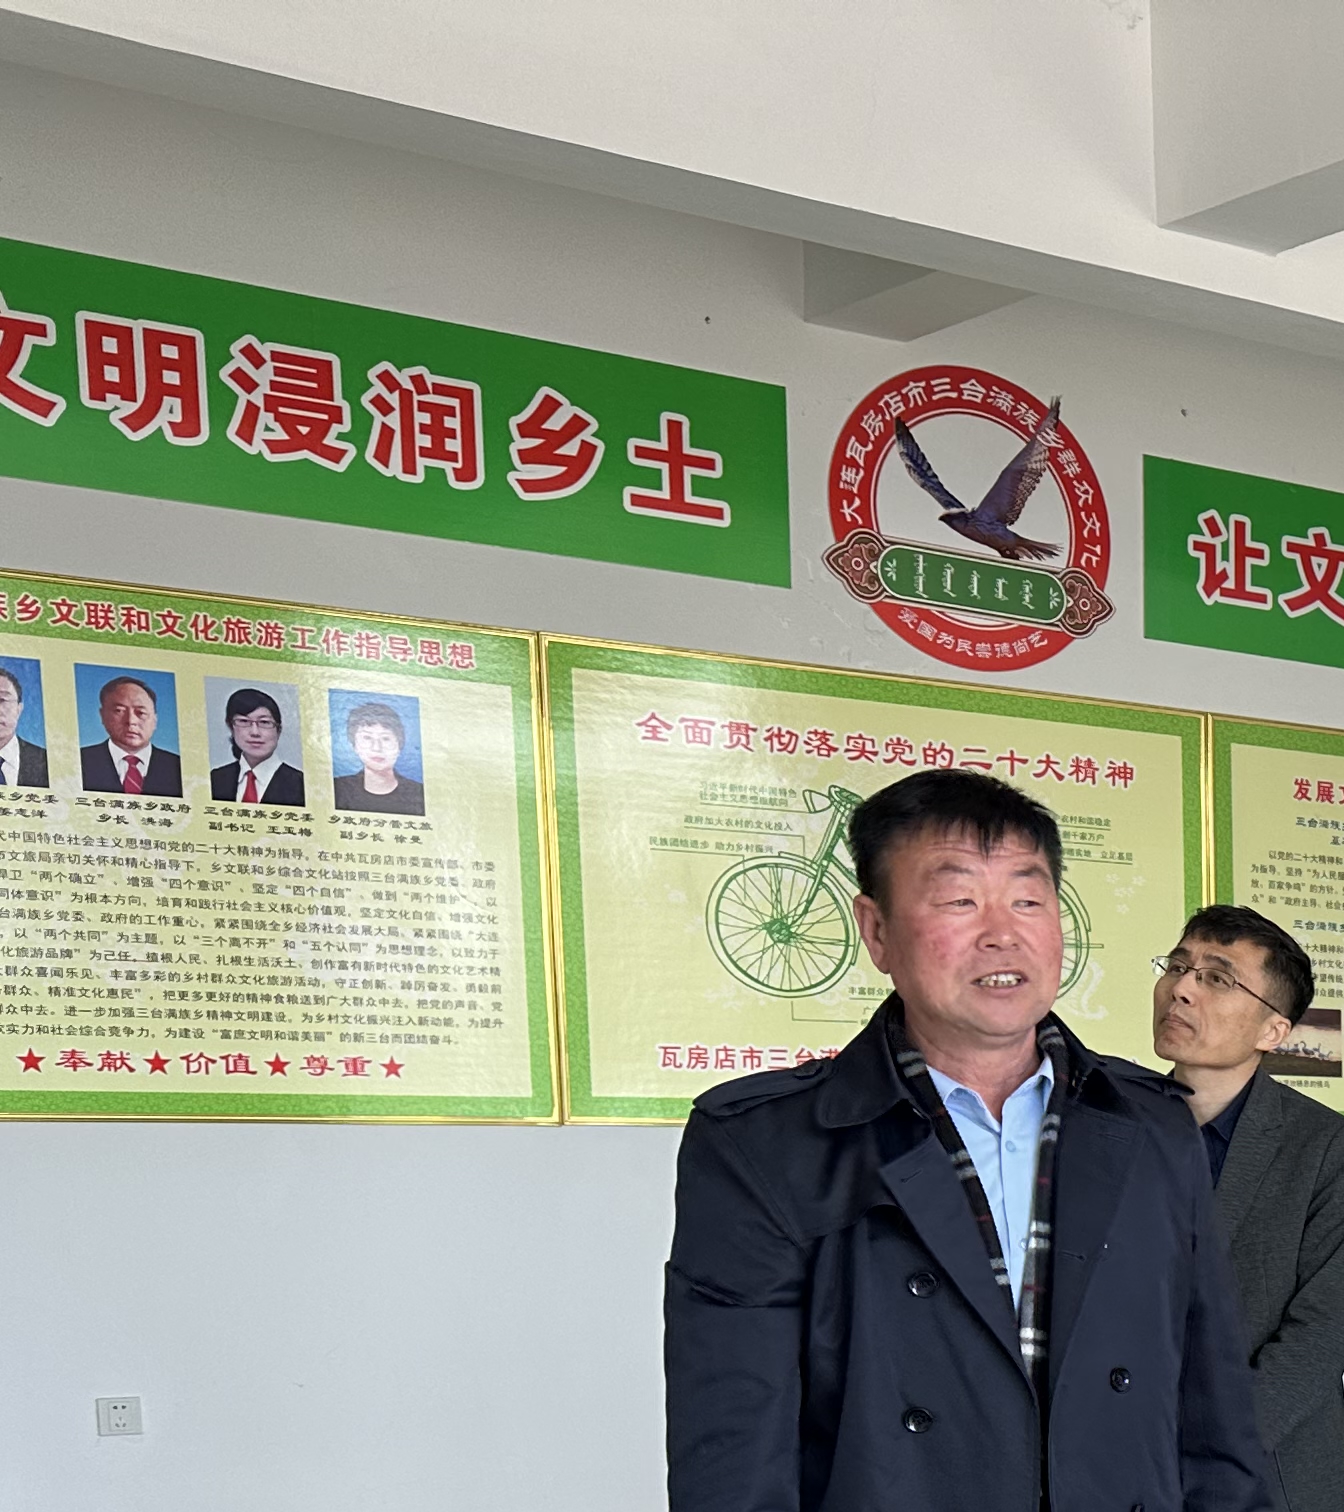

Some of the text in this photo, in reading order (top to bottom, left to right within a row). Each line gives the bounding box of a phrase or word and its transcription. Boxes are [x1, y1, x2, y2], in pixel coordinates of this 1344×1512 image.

[634, 709, 1136, 790] 全面贯彻落实党的二十大精神
[75, 796, 191, 815] 三台满族乡政府
[204, 805, 314, 823] 三台满族乡党委
[96, 813, 128, 825] 乡长
[207, 820, 255, 834] 副书记
[328, 814, 432, 831] 乡政府分管文旅
[339, 829, 383, 842] 副乡长
[55, 1048, 373, 1078] 奉献 价值 尊重
